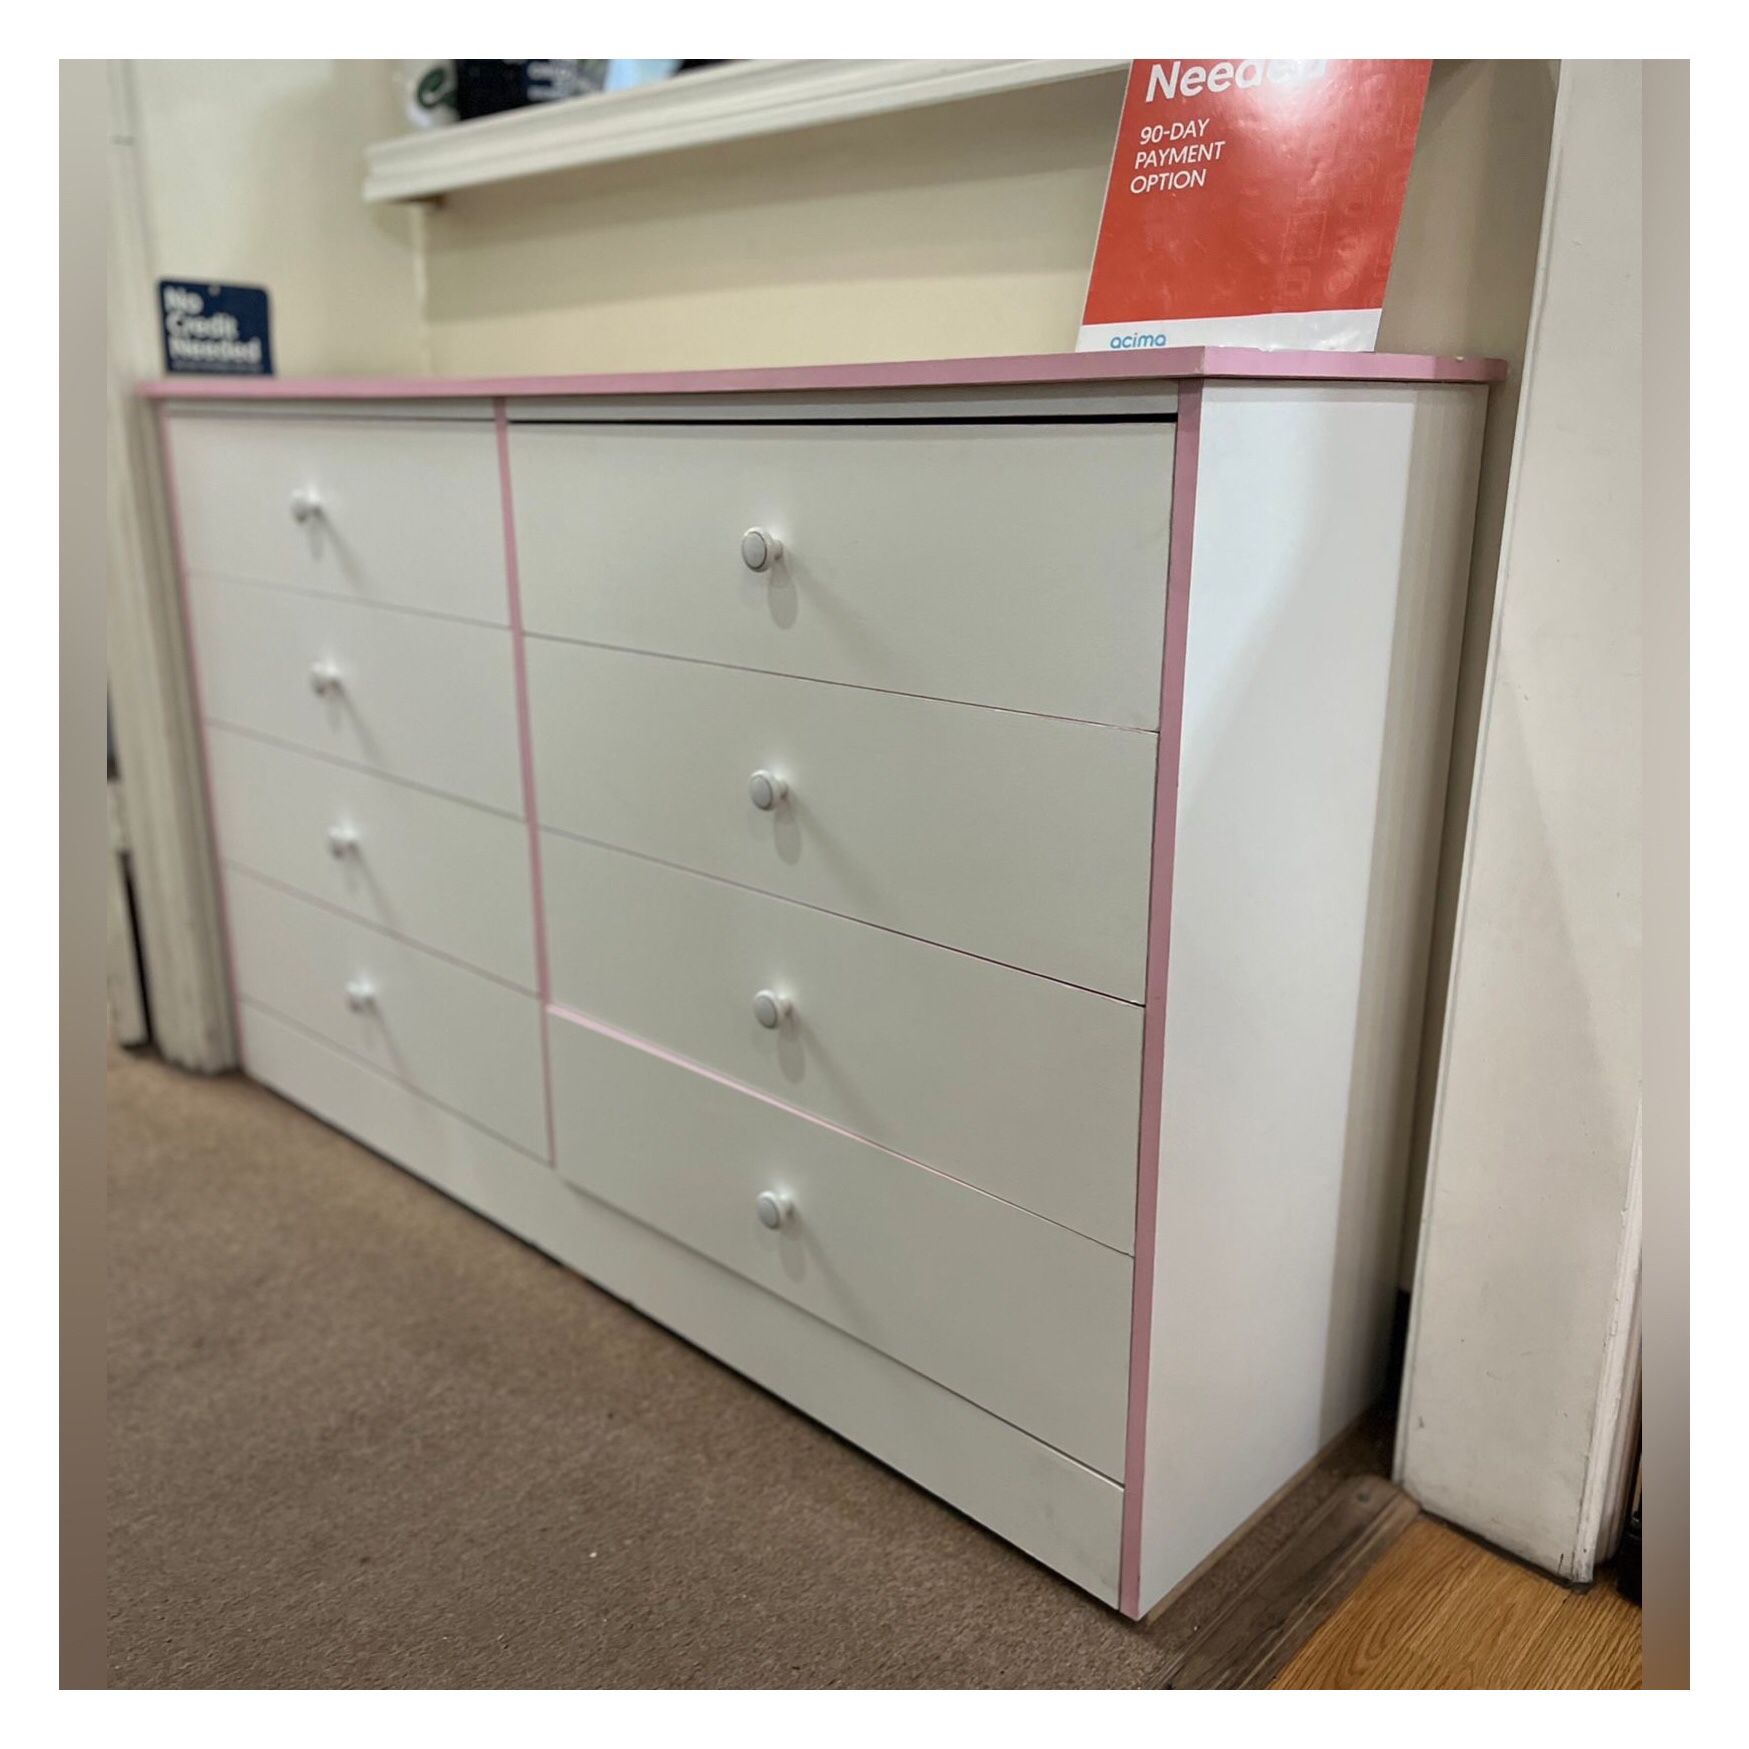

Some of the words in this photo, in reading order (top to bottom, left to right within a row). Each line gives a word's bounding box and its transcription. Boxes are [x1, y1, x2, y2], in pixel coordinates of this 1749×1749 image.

[1140, 118, 1210, 145] 90-DAY
[1134, 141, 1226, 170] PAYMENT
[1130, 168, 1207, 194] OPTION
[163, 285, 204, 315] No
[1110, 332, 1166, 349] acima
